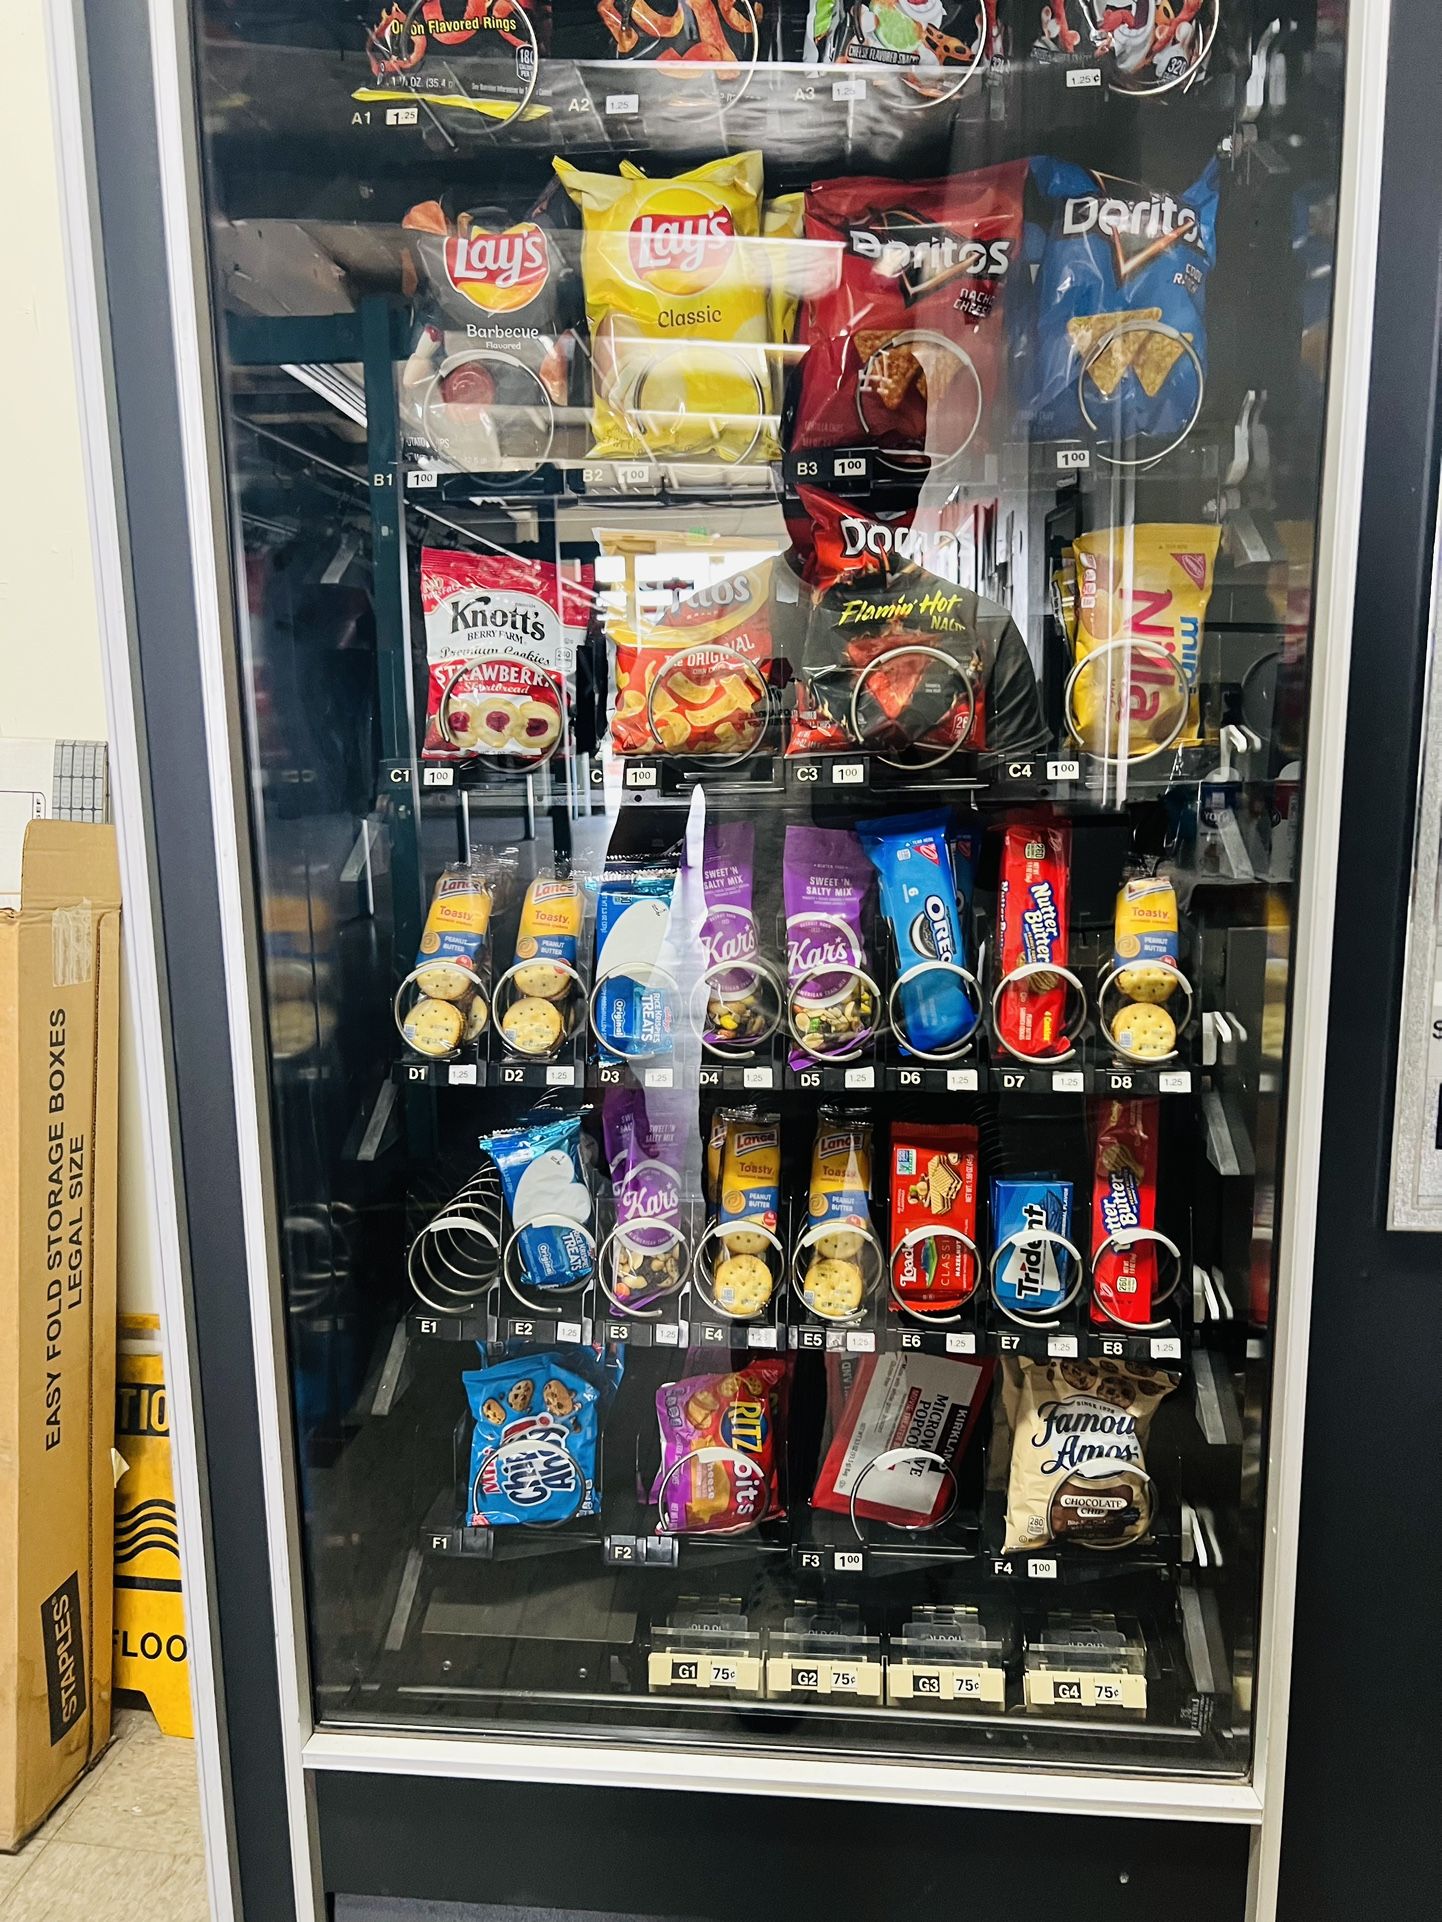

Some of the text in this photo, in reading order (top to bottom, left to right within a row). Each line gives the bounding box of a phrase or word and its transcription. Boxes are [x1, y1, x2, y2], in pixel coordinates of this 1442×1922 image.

[427, 15, 517, 34] Flavored Rings
[1168, 58, 1186, 74] 320
[794, 86, 816, 101] A3
[568, 98, 591, 112] A2
[610, 101, 629, 110] 1.25
[351, 111, 372, 125] A1
[393, 111, 416, 125] 1.25
[638, 210, 729, 271] Lay's
[453, 231, 547, 288] Lay's
[850, 230, 1010, 276] Doritos
[657, 306, 722, 328] Classic
[466, 324, 539, 339] Barbecue
[485, 341, 521, 350] Flavored
[796, 462, 818, 475] B3
[373, 475, 393, 487] B1
[582, 469, 603, 482] B2
[838, 589, 963, 626] Flamin' Hot
[450, 596, 546, 641] Knott's
[467, 628, 498, 641] BERRY
[439, 646, 551, 666] Premium Cookies
[463, 682, 530, 695] Shortbread
[390, 770, 411, 782] C1
[590, 770, 604, 783] C
[796, 766, 819, 781] C3
[1008, 763, 1032, 777] C4
[1034, 843, 1045, 858] 260
[704, 867, 728, 880] SWEET
[703, 875, 744, 890] SALTY MIX
[809, 876, 839, 887] SWEET
[805, 886, 853, 897] SALTY MIX
[908, 887, 920, 897] 6
[439, 905, 474, 922] Toasty
[535, 909, 570, 924] Toasty
[1030, 882, 1058, 938] Nutter
[1131, 906, 1170, 920] Toasty
[444, 935, 468, 945] PEANUT
[1023, 909, 1052, 963] Butter
[1143, 936, 1168, 945] PEANUT
[443, 944, 465, 953] BUTTER
[541, 939, 565, 949] PEANUT
[1143, 944, 1167, 953] BUTTER
[540, 947, 563, 956] BUTTER
[612, 1000, 625, 1038] Original
[641, 994, 653, 1042] TREATS
[652, 1011, 661, 1043] KRISPIES
[408, 1067, 426, 1080] D1
[452, 1070, 469, 1079] 1.25
[504, 1069, 524, 1082] D2
[551, 1071, 568, 1080] 1.25
[600, 1070, 620, 1083] D3
[651, 1073, 667, 1082] 1.25
[700, 1072, 718, 1084] D4
[746, 1073, 763, 1082] 1.25
[801, 1073, 820, 1086] D5
[849, 1073, 867, 1083] 1.25
[900, 1071, 921, 1084] D6
[951, 1075, 969, 1085] 1.25
[1003, 1075, 1025, 1088] D7
[1061, 1077, 1078, 1086] 1.25
[1111, 1075, 1132, 1089] D8
[1165, 1077, 1182, 1086] 1.25
[736, 1132, 778, 1149] Lance
[739, 1161, 775, 1175] Toasty
[748, 1192, 772, 1201] PEANUT
[832, 1195, 855, 1205] PEANUT
[1111, 1173, 1138, 1226] Butter
[748, 1200, 771, 1209] BUTTER
[831, 1203, 853, 1212] BUTTER
[68, 1133, 85, 1311] LEGAL SIZE
[46, 1007, 66, 1452] EASY FOLD STORAGE BOXES
[562, 1234, 582, 1272] TREATS
[537, 1243, 555, 1277] Original
[1118, 1278, 1128, 1291] 260
[420, 1321, 437, 1333] E1
[515, 1323, 533, 1335] E2
[561, 1328, 577, 1337] 1.25
[609, 1326, 628, 1338] E3
[659, 1330, 676, 1339] 1.25
[705, 1328, 724, 1340] E4
[803, 1333, 823, 1346] E5
[902, 1334, 921, 1347] E6
[852, 1337, 869, 1346] 1.25
[949, 1339, 966, 1348] 1.25
[1001, 1336, 1021, 1350] E7
[1054, 1342, 1071, 1351] 1.25
[1103, 1342, 1123, 1355] E8
[1156, 1344, 1174, 1353] 1.25
[1076, 1401, 1097, 1409] SINCE
[727, 1401, 763, 1453] RITZ
[1031, 1401, 1137, 1447] Famou
[910, 1393, 949, 1477] MICROWVE
[707, 1461, 715, 1500] heese
[734, 1460, 760, 1515] bits
[1064, 1497, 1122, 1509] CHOCOLATE
[1029, 1517, 1044, 1527] 280
[432, 1537, 448, 1550] F1
[614, 1547, 632, 1558] F2
[802, 1555, 820, 1567] F3
[994, 1562, 1013, 1575] F4
[53, 1591, 77, 1724] STAPLES
[678, 1664, 696, 1678] G1
[797, 1671, 818, 1686] G2
[918, 1677, 939, 1692] G3
[1057, 1684, 1080, 1698] G4
